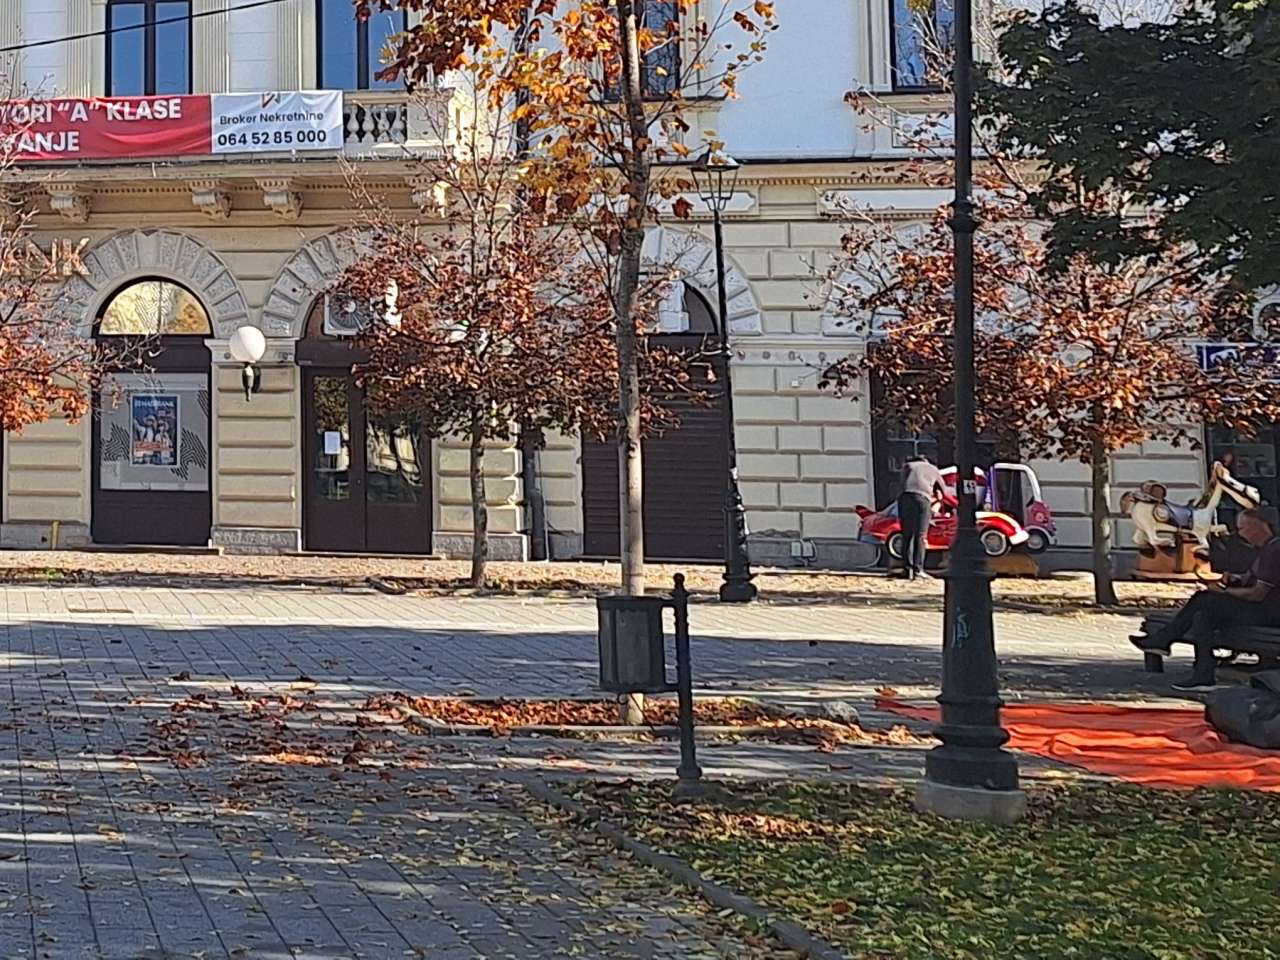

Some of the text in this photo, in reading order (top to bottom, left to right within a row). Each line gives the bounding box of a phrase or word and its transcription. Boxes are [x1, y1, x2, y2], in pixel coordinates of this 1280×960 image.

[106, 99, 182, 122] KLASE
[219, 110, 324, 126] Broker Nekretnine
[217, 130, 327, 146] 064 52 85 000
